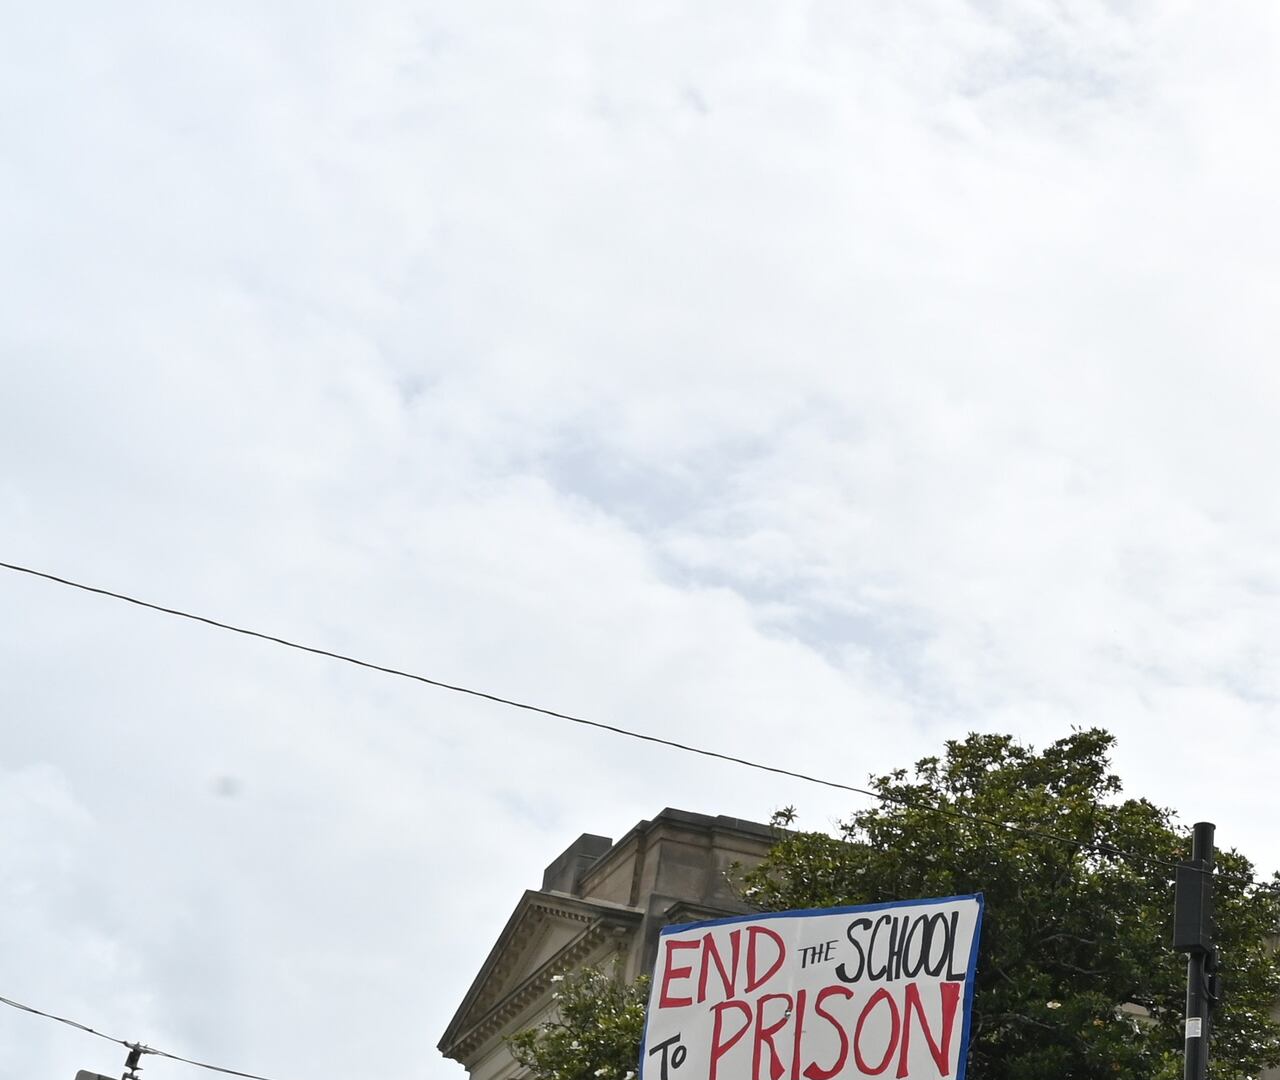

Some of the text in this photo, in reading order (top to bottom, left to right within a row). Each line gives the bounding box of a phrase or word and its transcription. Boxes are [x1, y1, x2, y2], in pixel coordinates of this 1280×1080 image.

[658, 910, 967, 1010] END THE SCHOOL
